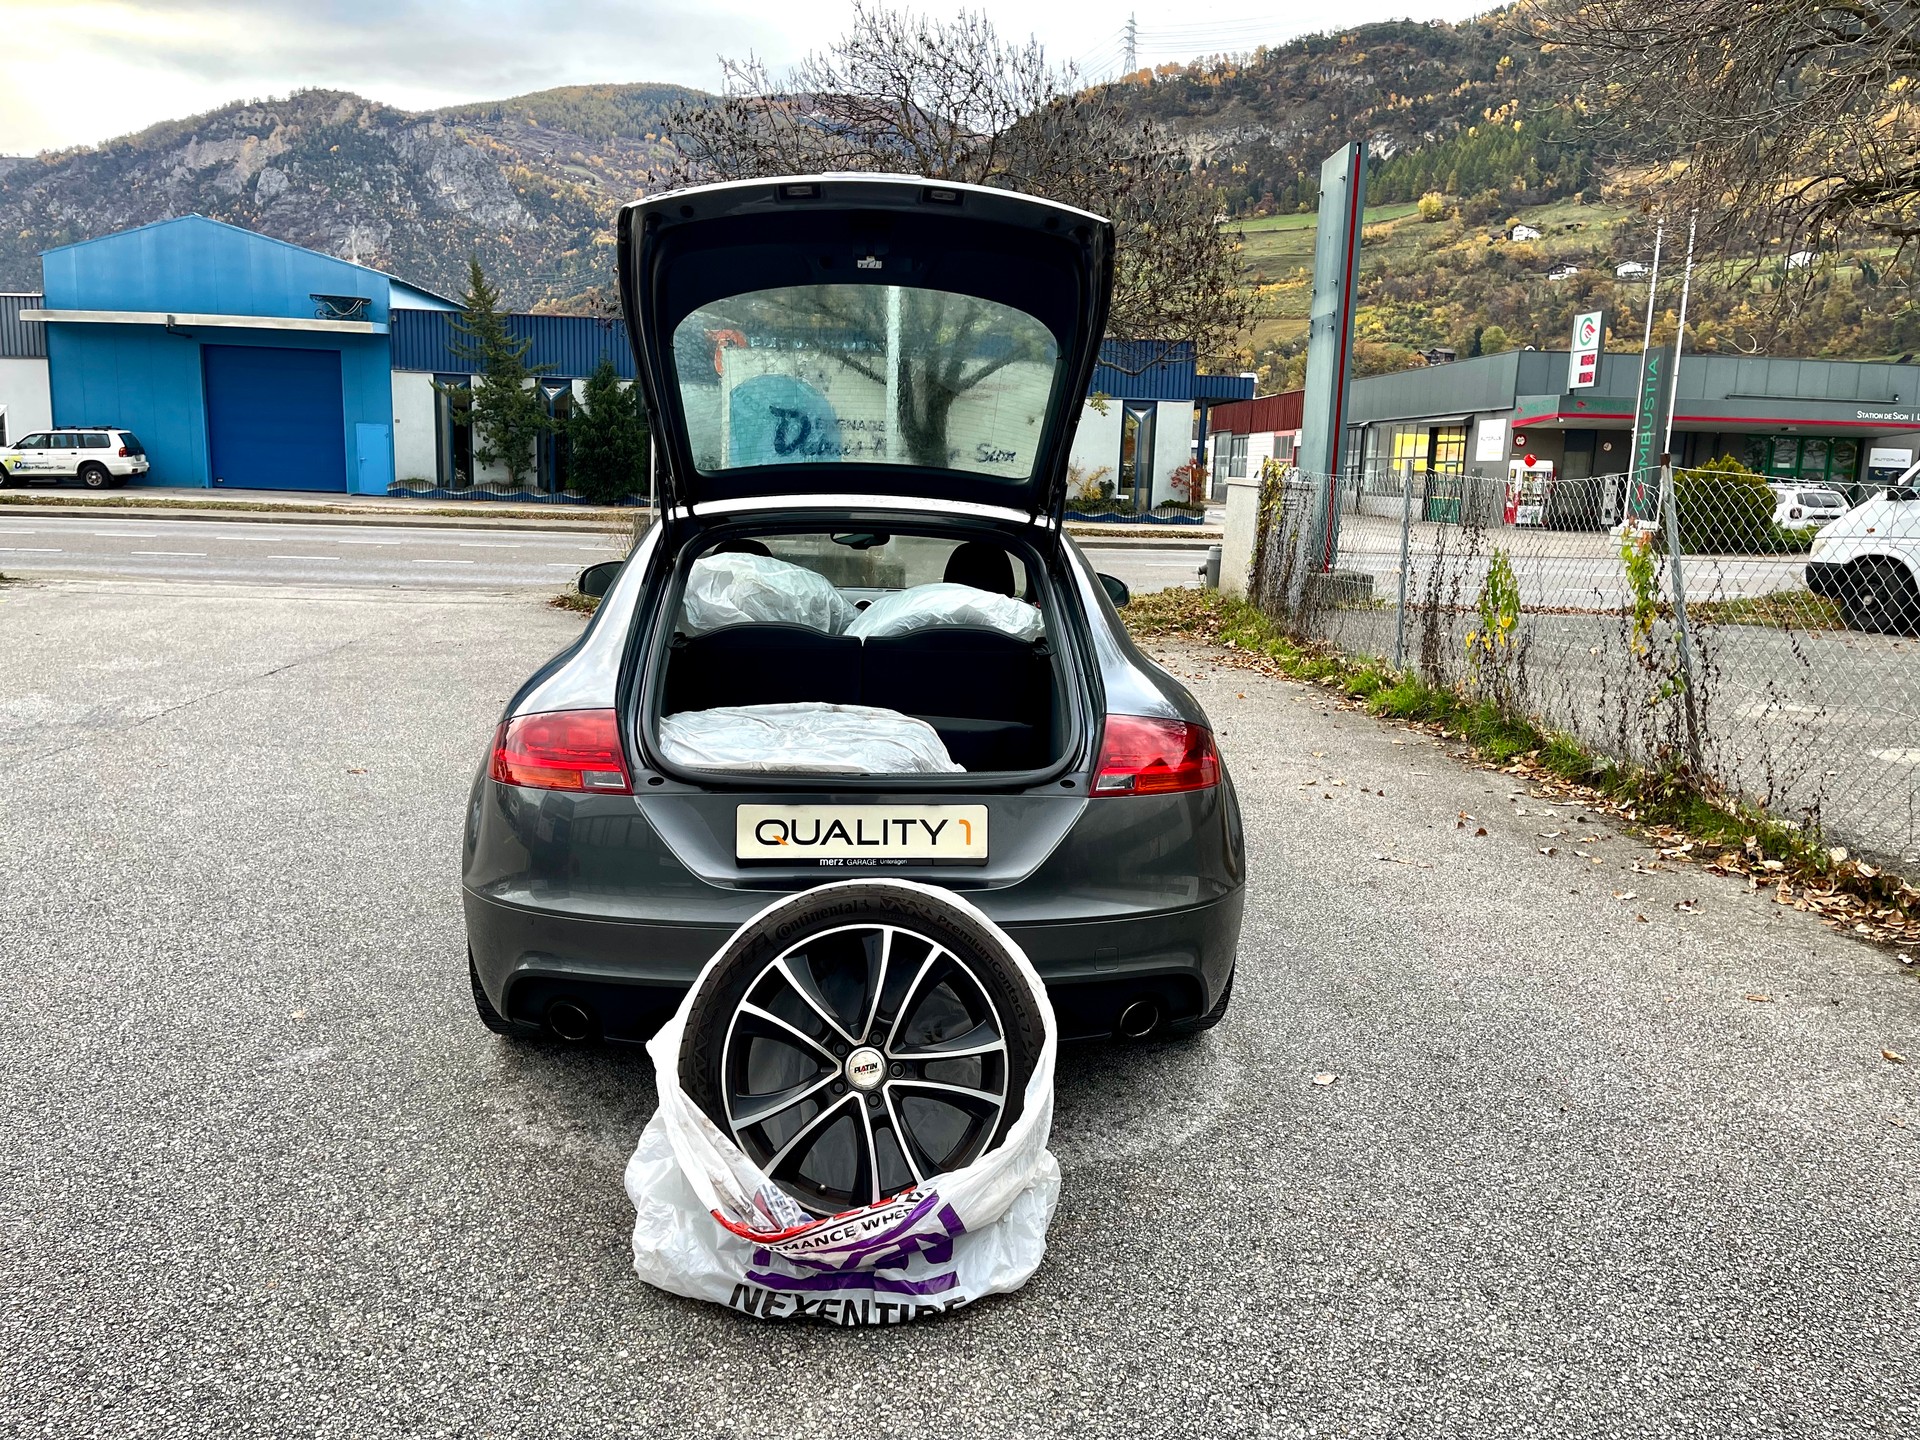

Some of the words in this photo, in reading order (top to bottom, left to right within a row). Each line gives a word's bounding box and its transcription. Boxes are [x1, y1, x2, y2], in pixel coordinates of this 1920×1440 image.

[755, 819, 949, 845] QUALITY
[959, 819, 971, 845] 1
[820, 858, 844, 866] merz
[846, 858, 877, 866] GARAGE
[775, 900, 858, 939] Continental
[937, 914, 1027, 1019] PremiumContact
[1021, 1024, 1031, 1034] 7
[854, 1062, 878, 1073] PLATIN
